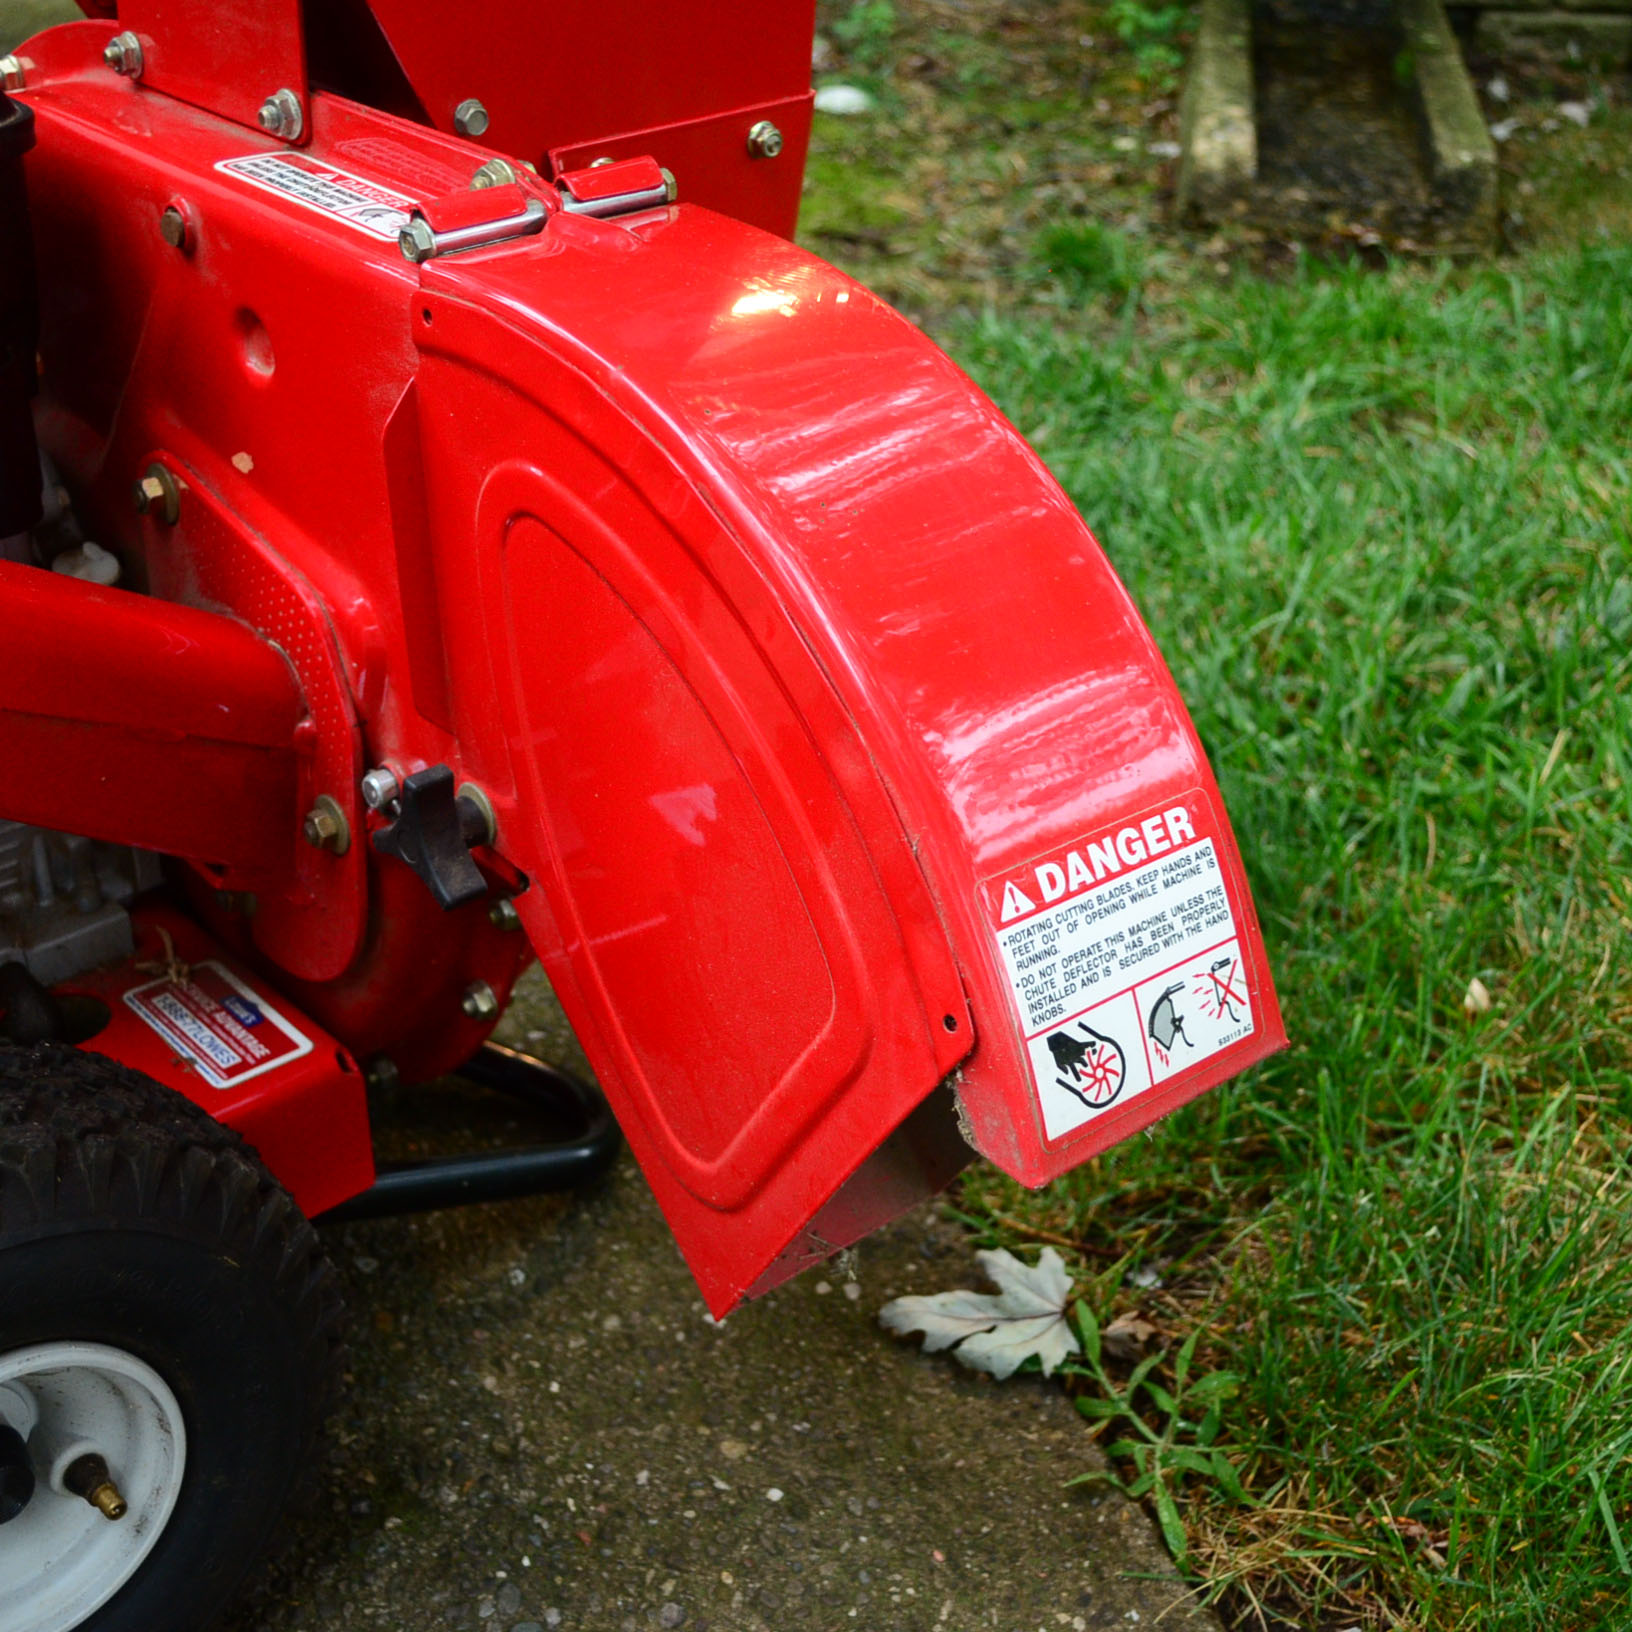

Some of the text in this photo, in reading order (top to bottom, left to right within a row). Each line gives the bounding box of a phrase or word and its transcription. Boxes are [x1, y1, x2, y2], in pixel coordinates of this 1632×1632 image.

[336, 178, 410, 208] DANGER
[1008, 918, 1054, 946] ROTATING
[1056, 899, 1095, 925] CUTTING
[1136, 869, 1159, 886] KEEP
[1162, 855, 1192, 873] HANDS
[1195, 846, 1212, 861] AND
[1034, 807, 1197, 904] DANGER
[1012, 858, 1216, 958] FEET OUT OF OPENING WHILE MACHINE IS
[1021, 886, 1223, 989] DO NOT OPERATE THIS MACHINE UNLESS THE
[1025, 898, 1225, 1001] CHUTE DEFLECTOR HAS BEEN PROPERLY
[1017, 945, 1061, 971] RUNNING.
[1028, 910, 1229, 1014] INSTALLED AND IS SECURED WITH THE HAND
[211, 1010, 272, 1059] ADVANTAGE
[1032, 1003, 1066, 1027] KNOBS.
